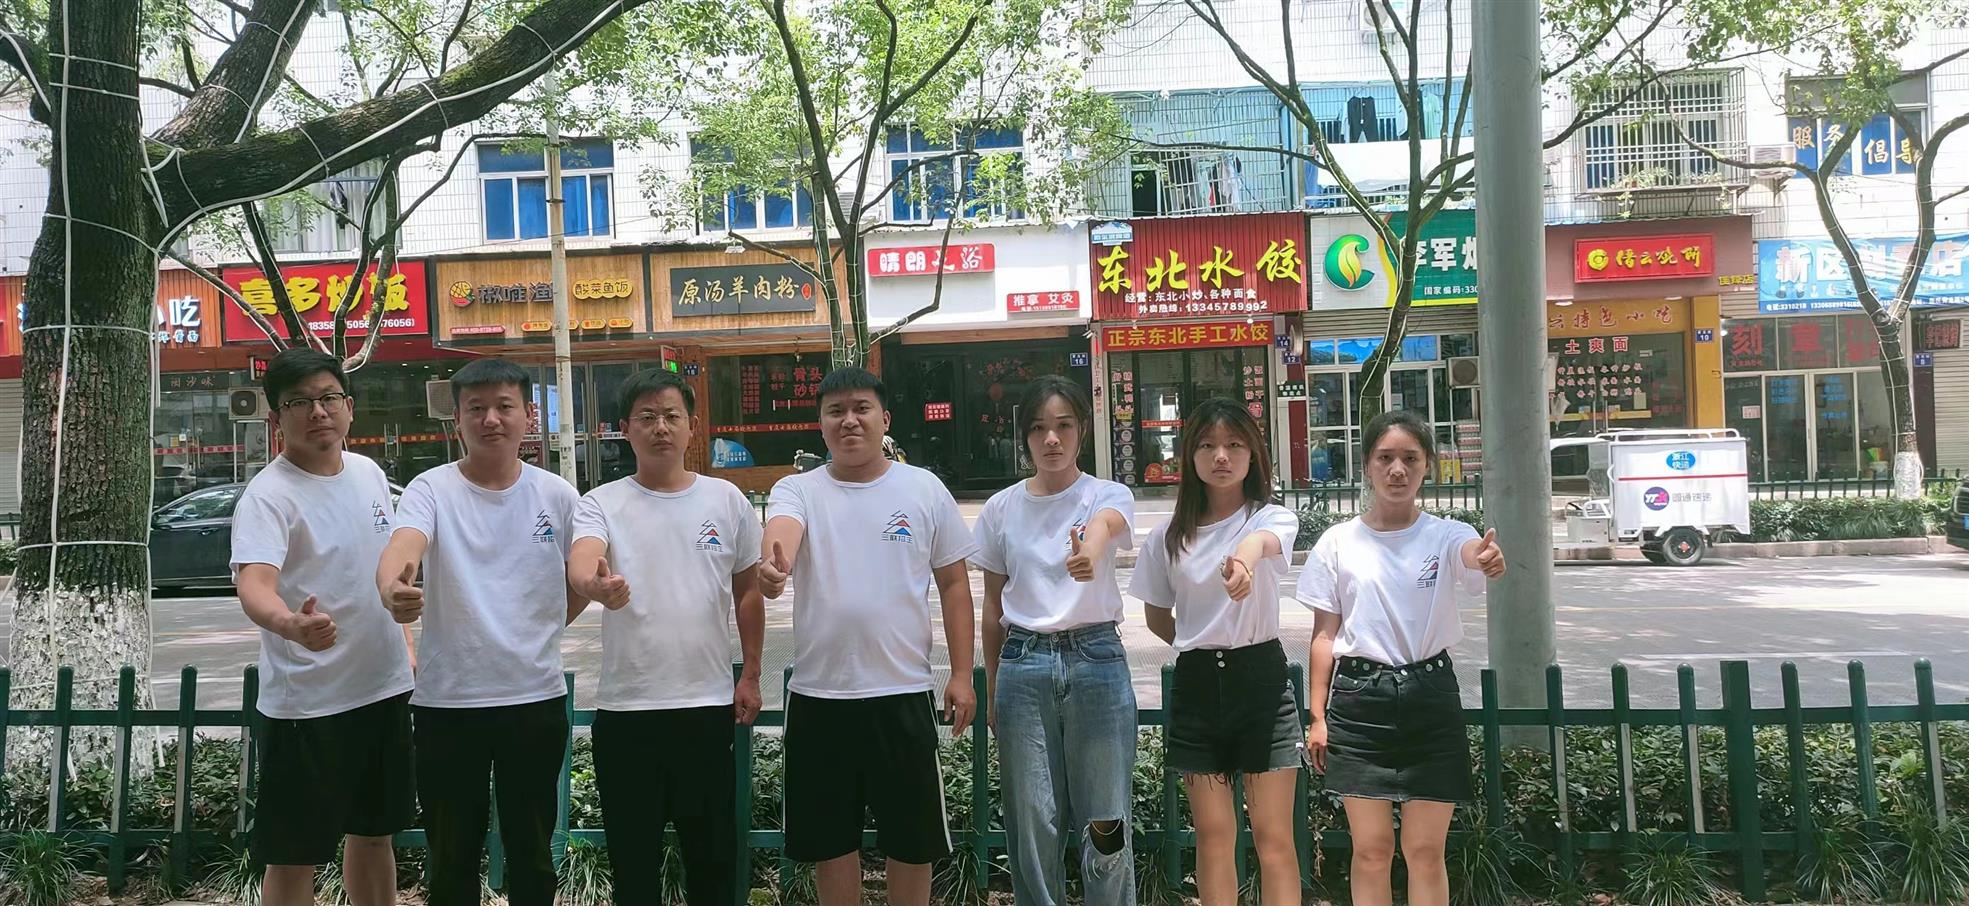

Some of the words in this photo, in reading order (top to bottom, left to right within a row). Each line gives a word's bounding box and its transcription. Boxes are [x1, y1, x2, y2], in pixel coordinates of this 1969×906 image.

[1097, 239, 1303, 296] 东北水饺
[239, 271, 410, 316] 喜多炒饭
[574, 280, 629, 296] 酸菜鱼饭
[678, 274, 800, 306] 原汤羊肉粉
[1013, 294, 1039, 307] 推拿
[1047, 292, 1074, 305] 艾灸
[1107, 323, 1270, 348] 正宗东北手工水饺
[1564, 336, 1629, 355] 土爽面
